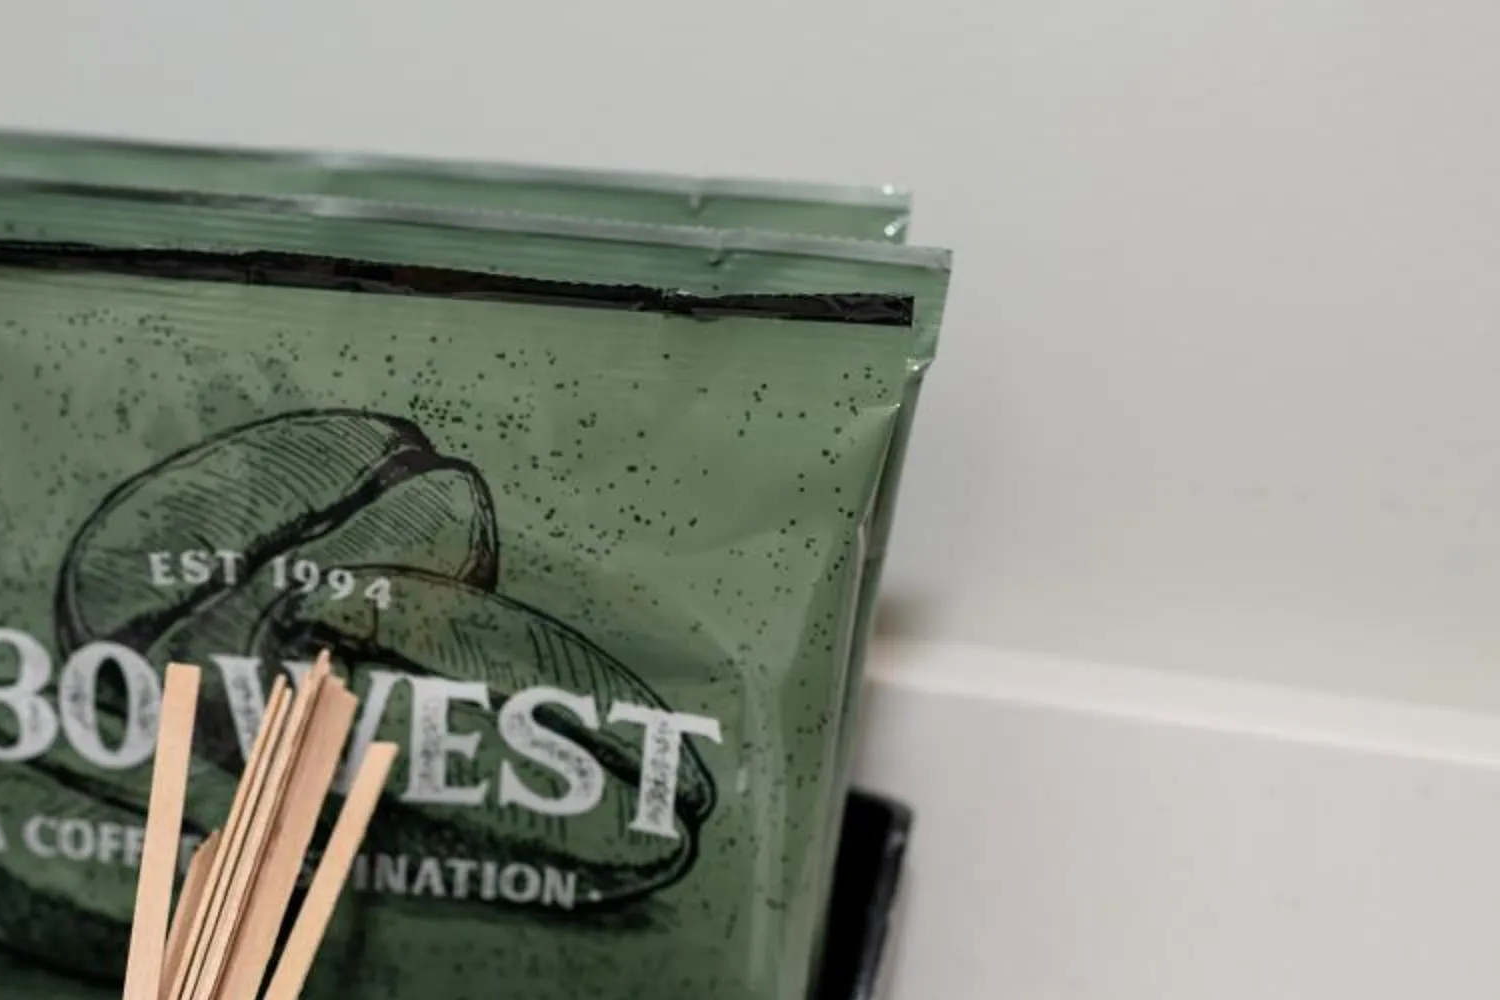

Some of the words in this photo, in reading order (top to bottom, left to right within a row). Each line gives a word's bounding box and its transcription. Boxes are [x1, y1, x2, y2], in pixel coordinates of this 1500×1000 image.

[148, 549, 243, 586] EST
[271, 555, 392, 611] 1994
[21, 814, 204, 875] COFF
[300, 848, 577, 911] INATION
